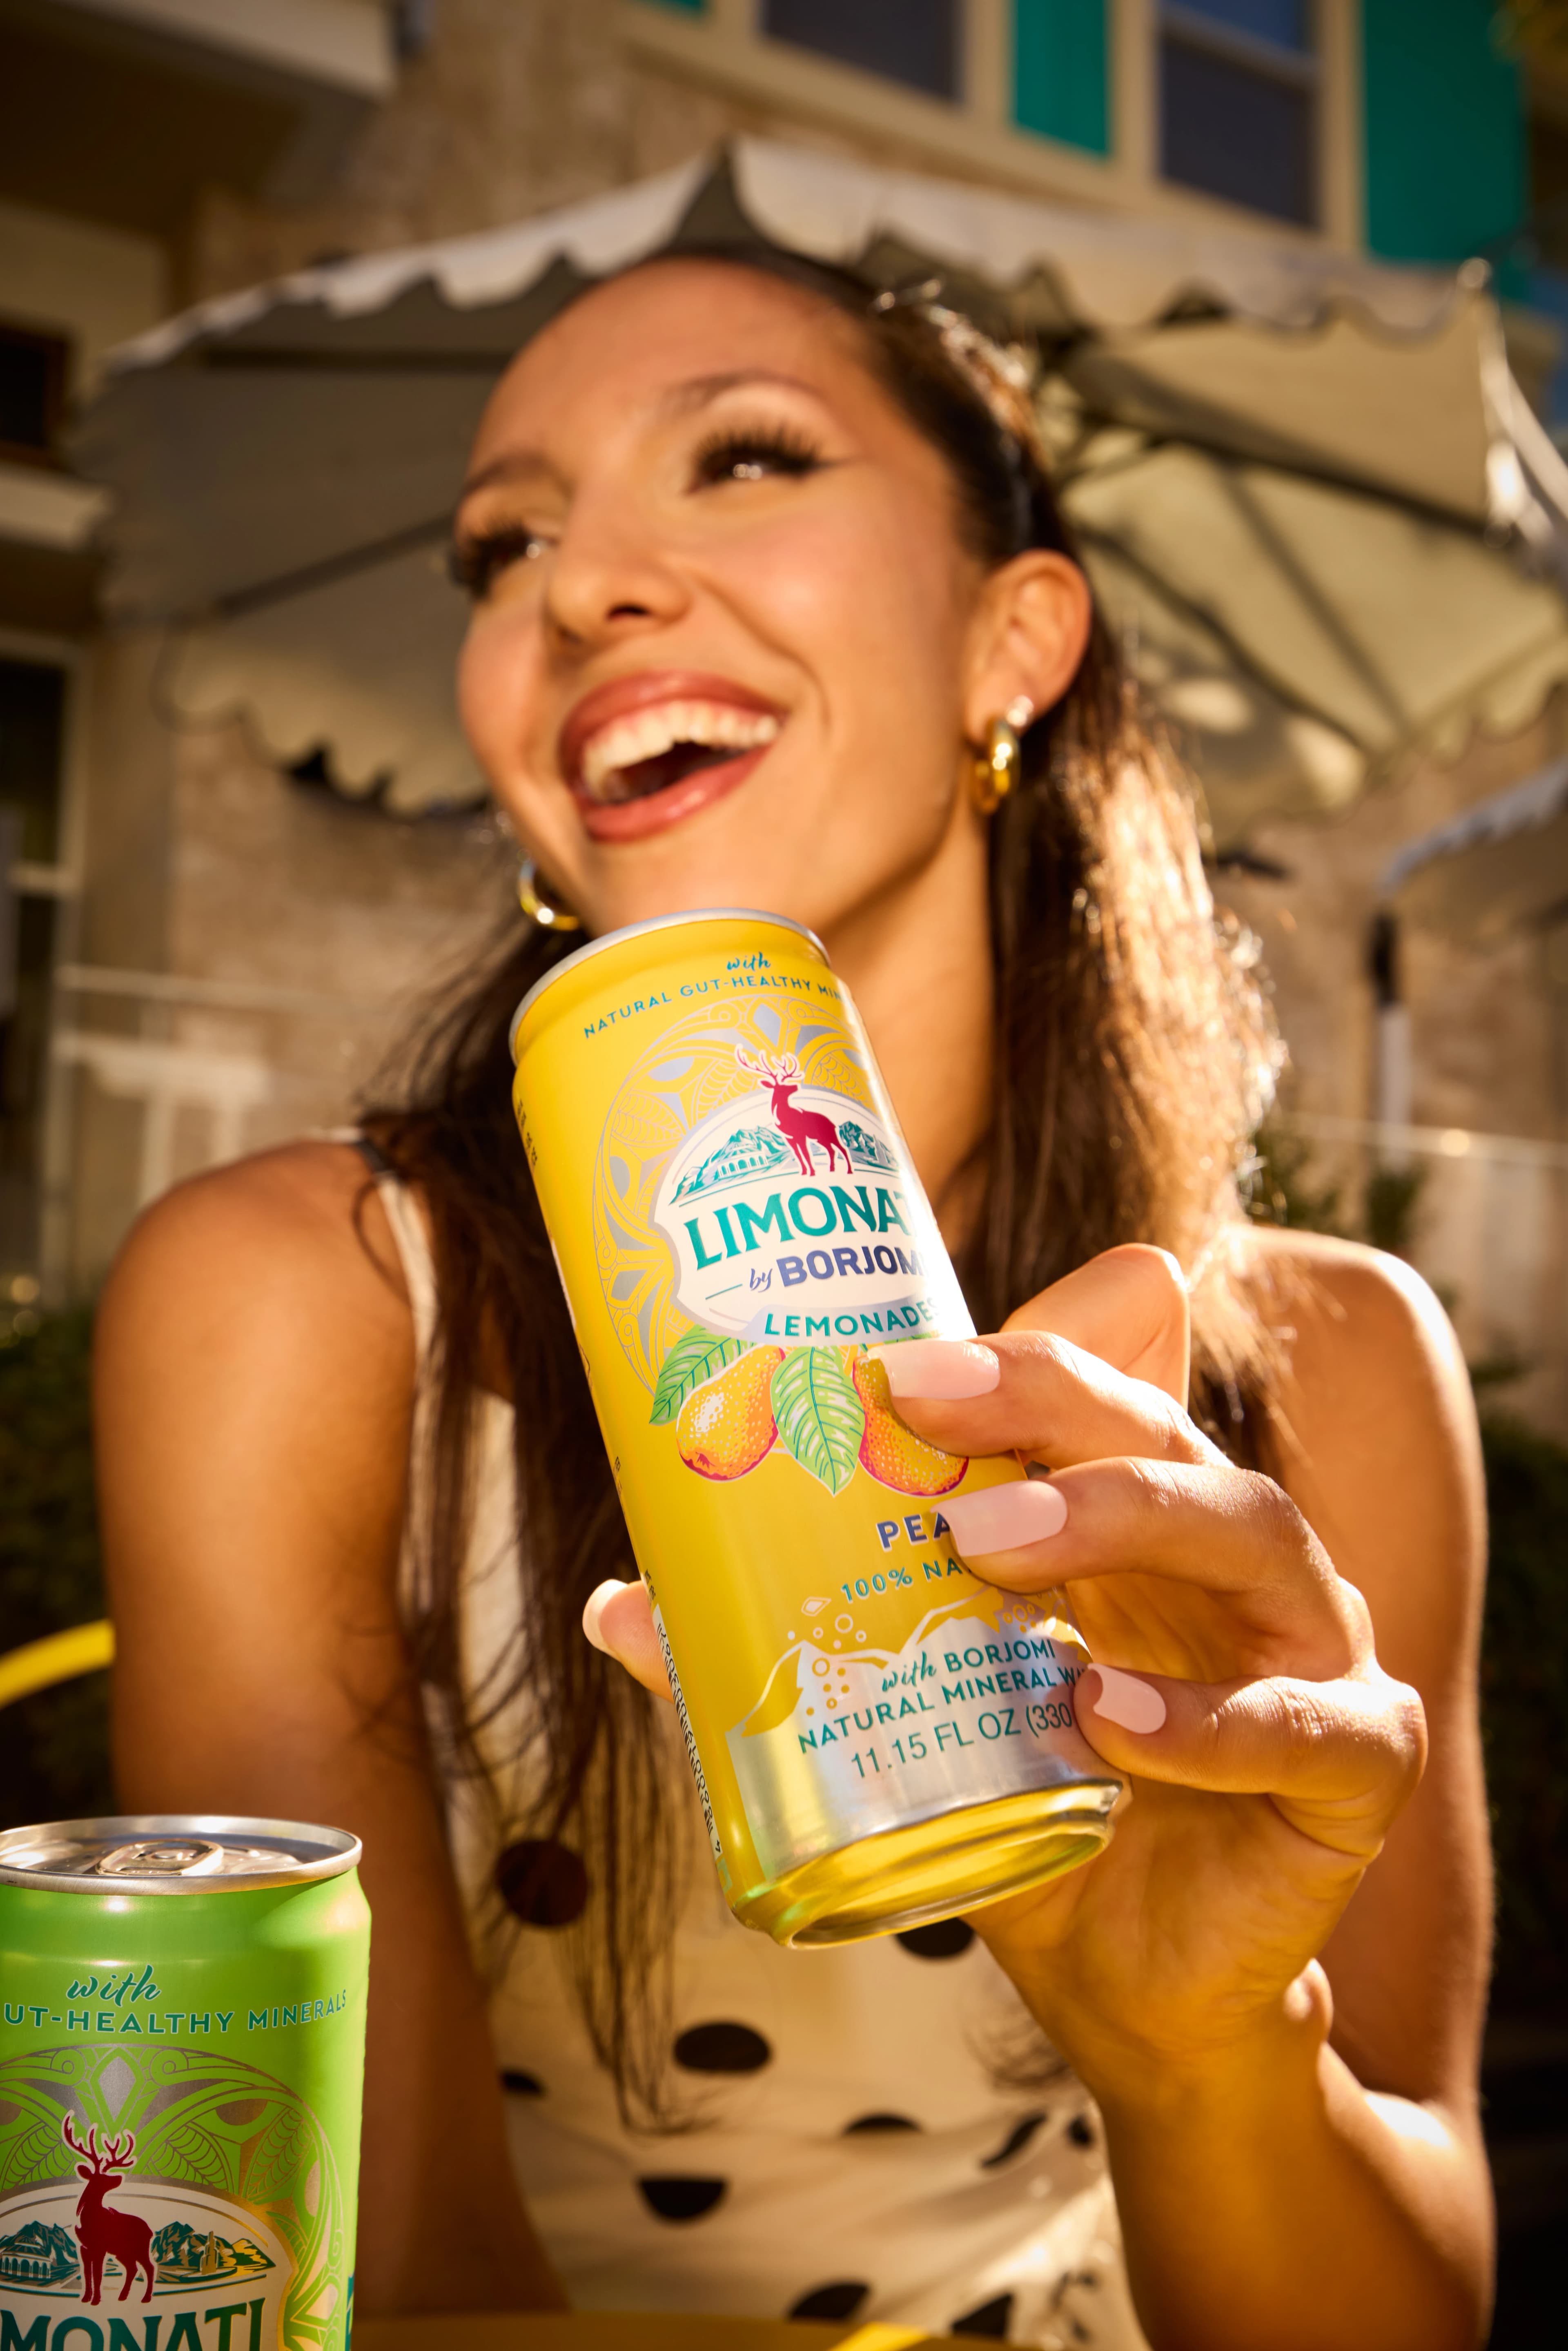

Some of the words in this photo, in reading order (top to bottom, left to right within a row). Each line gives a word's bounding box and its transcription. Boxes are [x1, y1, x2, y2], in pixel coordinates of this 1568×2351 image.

[726, 952, 771, 972] with
[584, 992, 672, 1039] NATURAL
[680, 975, 811, 997] GUT-HEALTHY
[749, 1268, 773, 1293] by
[876, 1512, 951, 1551] PEA
[841, 1567, 913, 1604] 100%
[881, 1651, 937, 1692] with
[944, 1639, 1056, 1673] BORJOMI
[798, 1693, 935, 1755] NATURAL
[942, 1667, 1057, 1704] MINERAL
[851, 1732, 927, 1778] 11.15
[934, 1721, 974, 1751] FL
[978, 1708, 1021, 1740] OZ
[1025, 1703, 1072, 1738] (330
[66, 1964, 162, 2007] with
[4, 2002, 235, 2034] UT-HEALTHY
[247, 1988, 347, 2031] MINERALS
